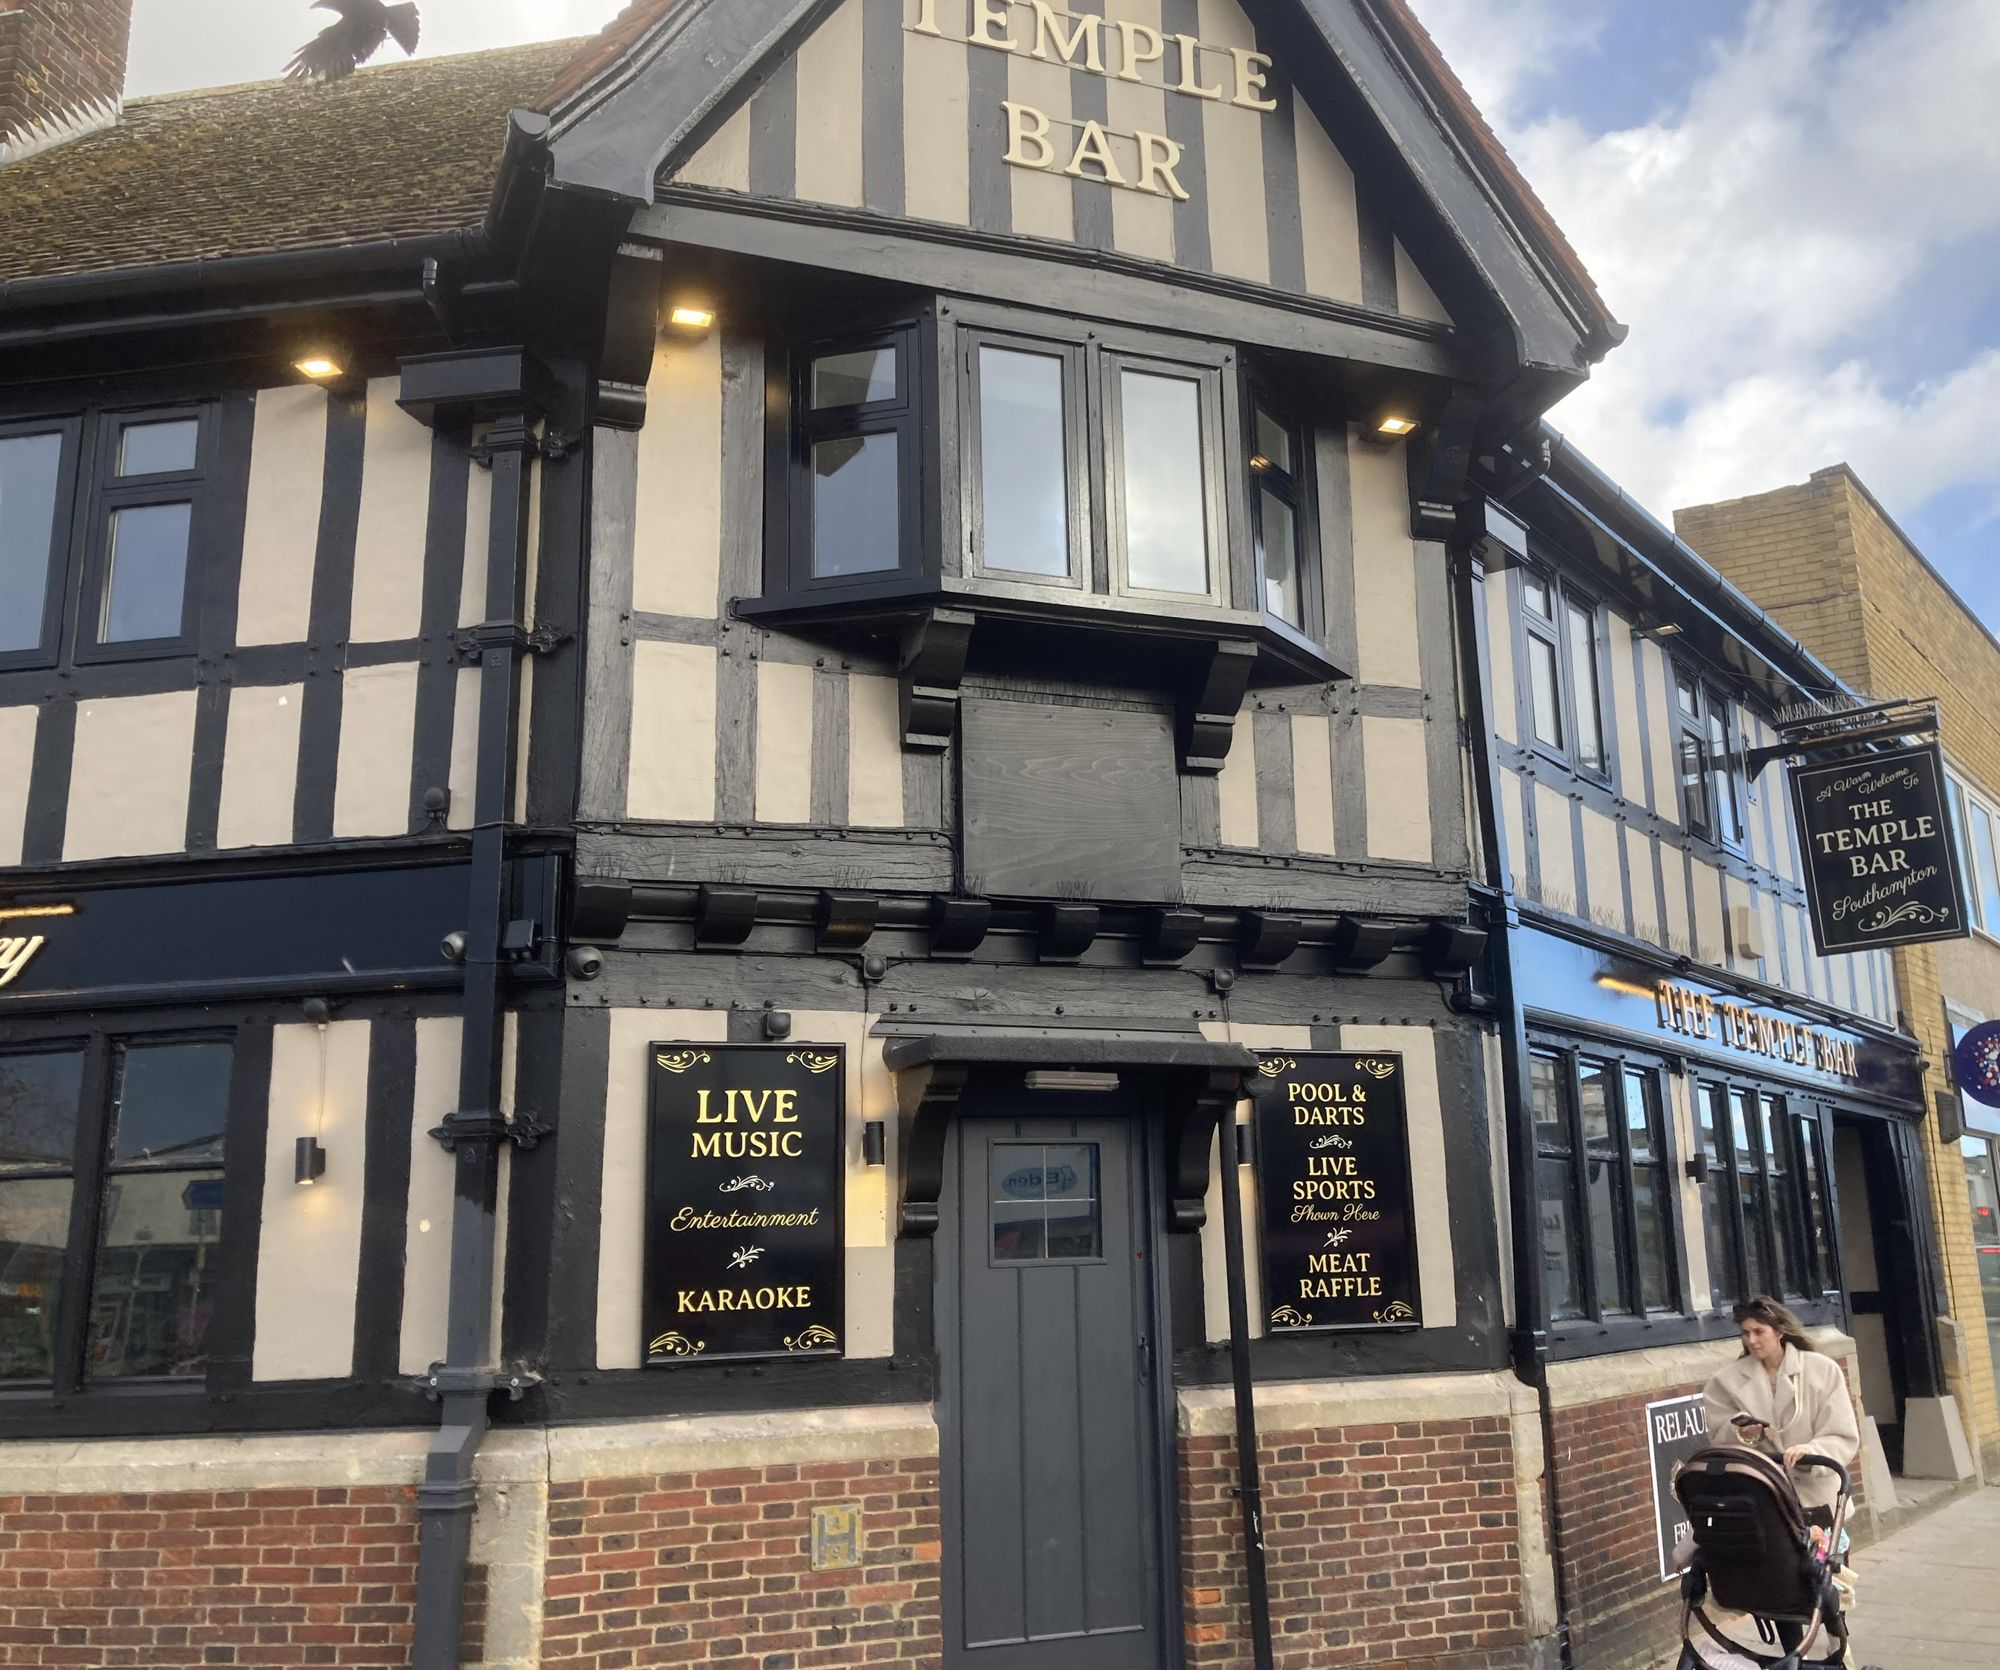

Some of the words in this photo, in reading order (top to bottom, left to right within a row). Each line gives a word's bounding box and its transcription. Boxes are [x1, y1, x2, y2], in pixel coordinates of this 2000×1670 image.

[1001, 101, 1190, 200] BAR
[1816, 785, 1832, 802] A
[1833, 771, 1872, 791] Warm
[1858, 767, 1909, 794] Welcome
[1903, 773, 1919, 790] To
[1849, 799, 1893, 820] THE
[1816, 816, 1936, 854] TEMPLE
[1849, 849, 1911, 877] BAR
[1832, 865, 1938, 921] Southampton
[1657, 978, 1718, 1041] THE
[1722, 1001, 1815, 1066] TEMPLE
[1821, 1033, 1859, 1078] BAR
[1288, 1083, 1347, 1102] POOL
[1352, 1084, 1367, 1102] &
[696, 1089, 799, 1124] LIVE
[1294, 1106, 1365, 1126] DARTS
[690, 1131, 803, 1158] MUSIC
[1308, 1156, 1358, 1176] LIVE
[1293, 1180, 1376, 1200] SPORTS
[670, 1206, 819, 1232] Entertainment
[1290, 1204, 1340, 1223] Shown
[1342, 1203, 1380, 1221] Here
[1308, 1253, 1371, 1274] MEAT
[677, 1286, 812, 1313] KARAOKE
[1300, 1276, 1383, 1299] RAFFLE
